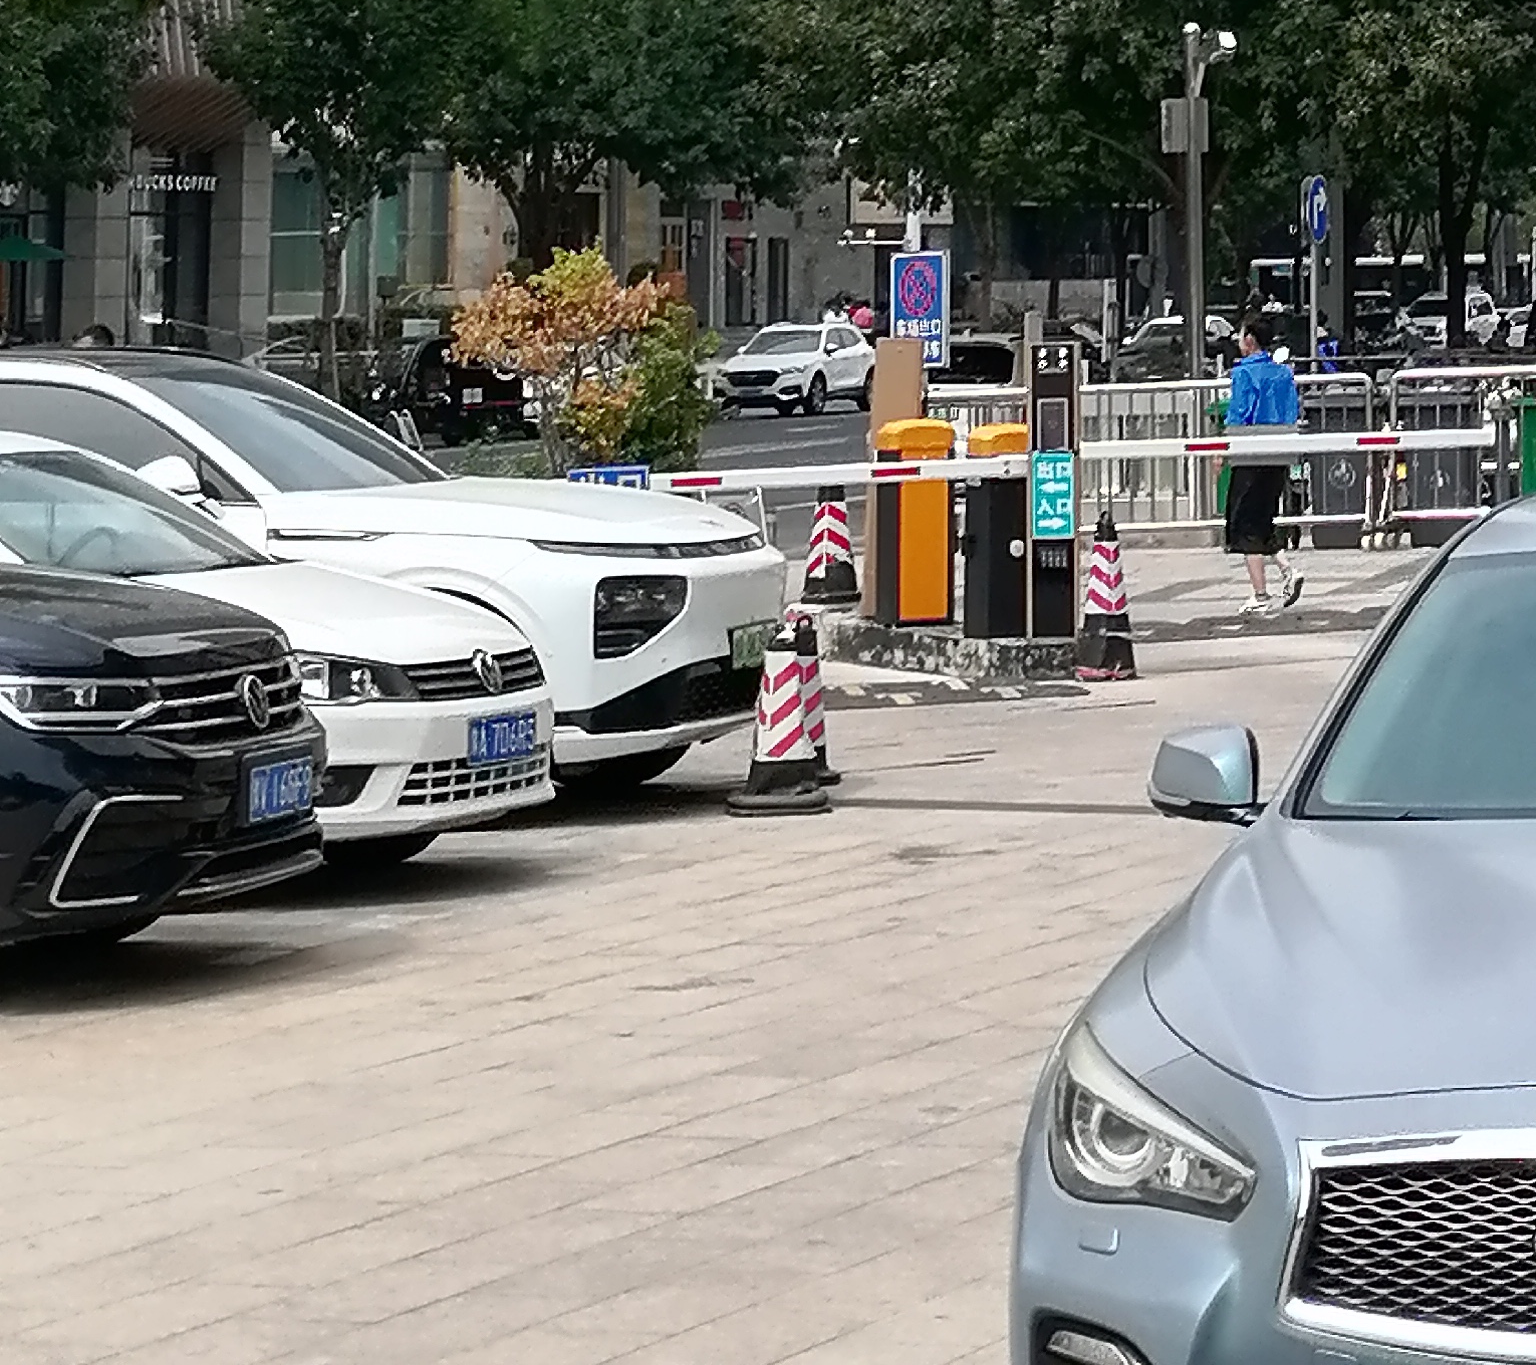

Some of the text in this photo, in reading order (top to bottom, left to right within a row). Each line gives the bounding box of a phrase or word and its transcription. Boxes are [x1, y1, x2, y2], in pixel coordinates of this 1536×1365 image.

[175, 174, 218, 191] COFFEE
[1036, 461, 1071, 479] 出口
[1036, 498, 1071, 515] 入口
